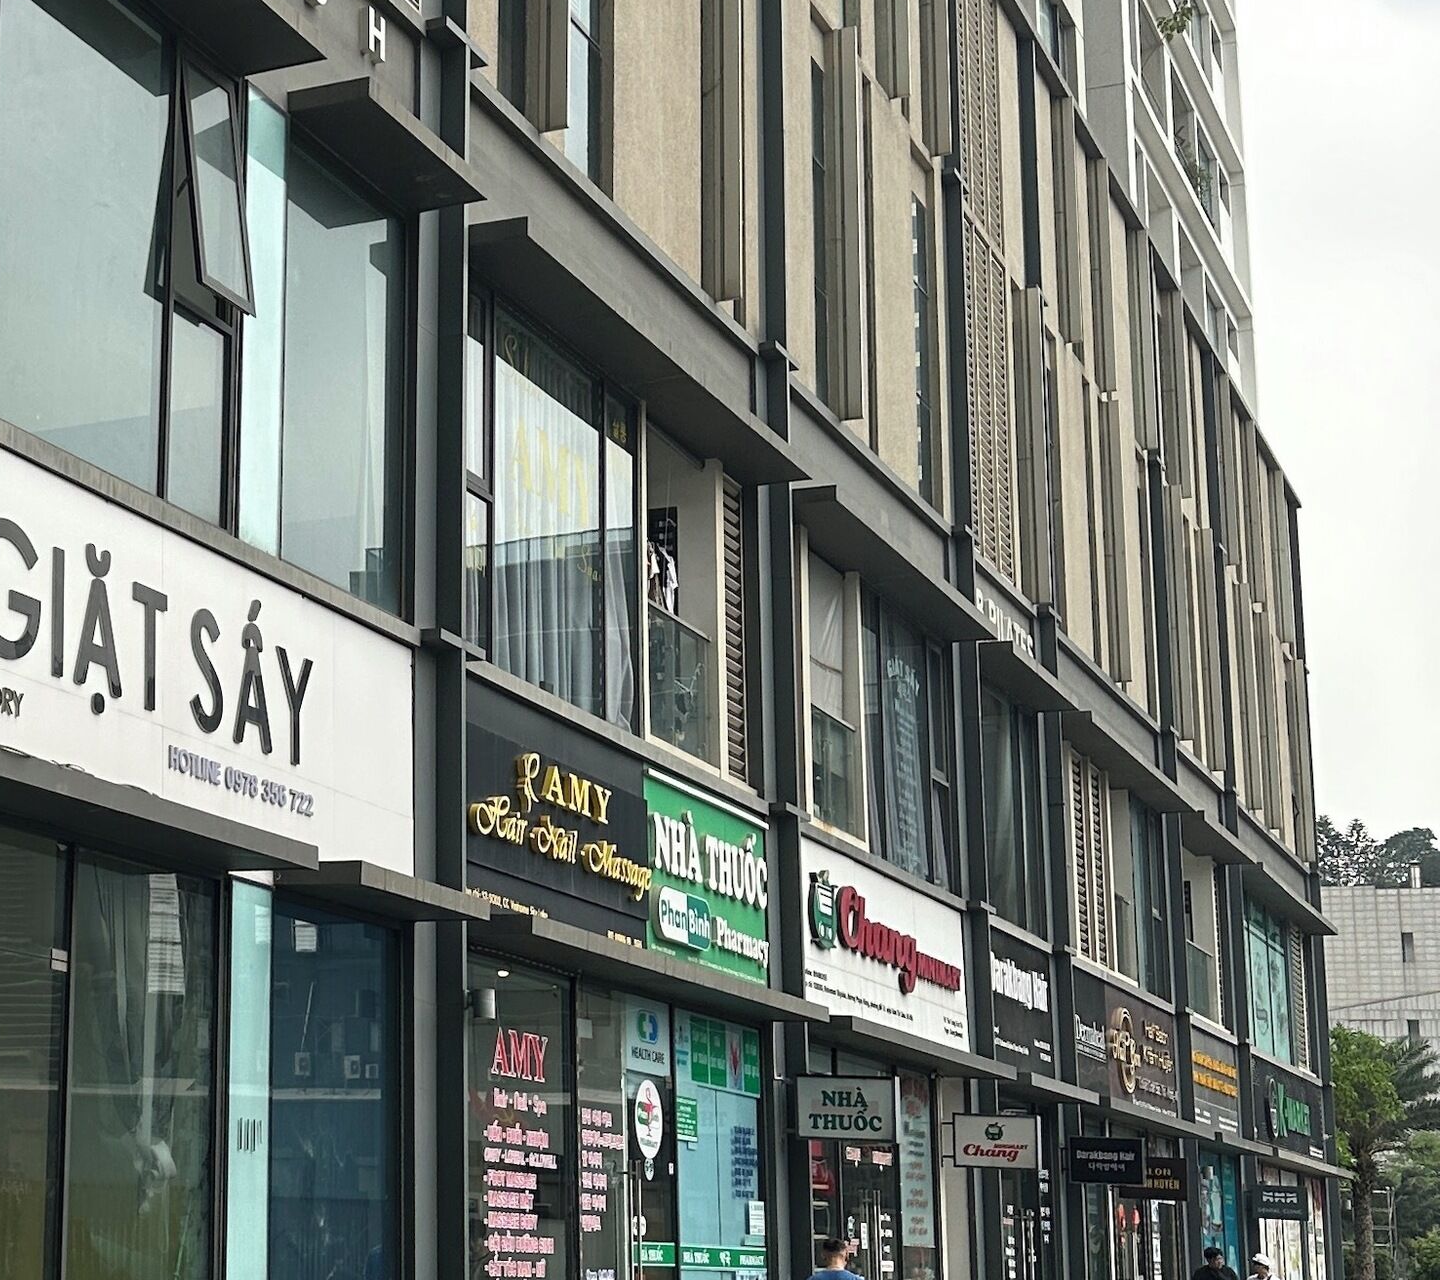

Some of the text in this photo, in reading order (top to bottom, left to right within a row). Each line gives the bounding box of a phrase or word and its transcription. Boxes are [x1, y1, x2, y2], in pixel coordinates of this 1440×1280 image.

[189, 599, 314, 766] SẤY
[168, 744, 221, 786] HOTLINE
[224, 766, 259, 799] 0978
[288, 788, 314, 817] 722
[540, 765, 613, 825] AMY
[469, 795, 528, 846] Hair
[652, 809, 768, 910] NHÀ THUỐC
[714, 916, 770, 969] Pharmacy
[836, 885, 917, 995] Chang
[490, 1026, 549, 1083] AMY
[632, 1046, 652, 1062] HEALTH
[809, 1110, 883, 1132] THUỐC
[821, 1087, 868, 1108] NHÀ
[962, 1143, 1020, 1162] Chang
